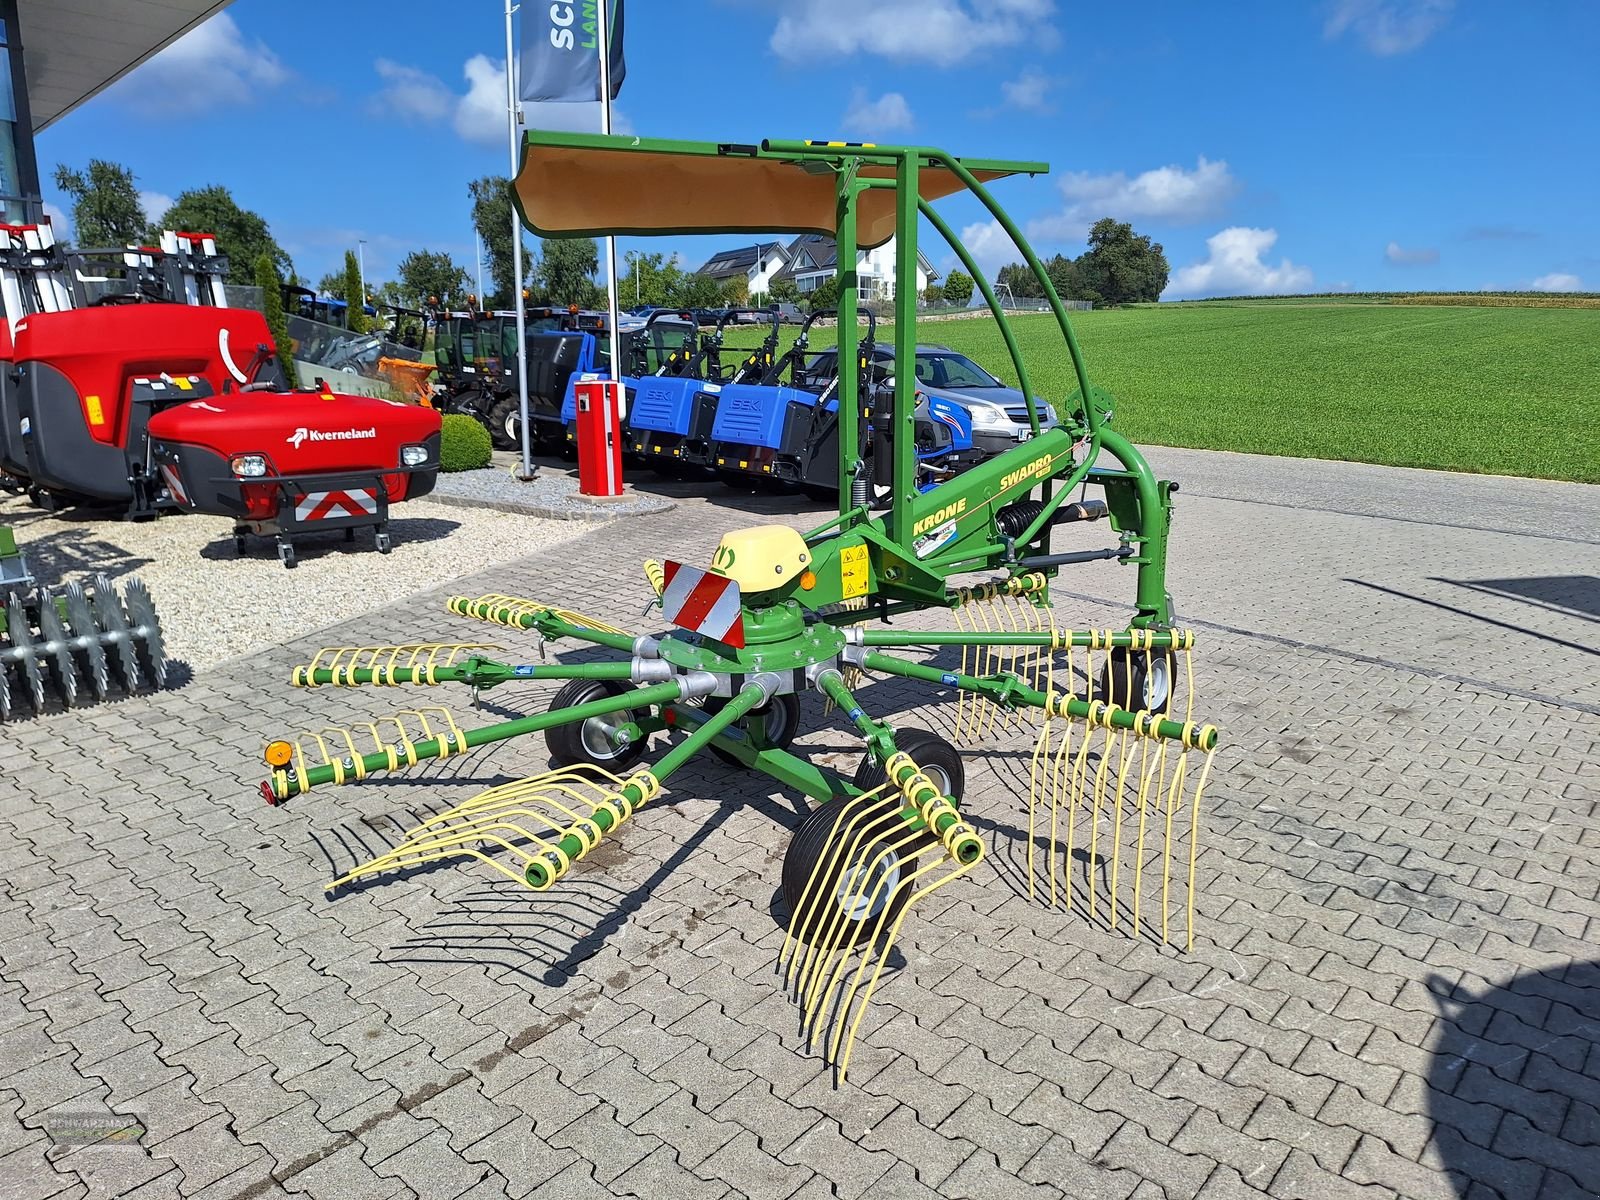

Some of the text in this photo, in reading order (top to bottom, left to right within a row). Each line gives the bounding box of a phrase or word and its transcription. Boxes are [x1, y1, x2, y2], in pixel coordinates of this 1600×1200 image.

[549, 0, 574, 51] SC
[581, 0, 597, 49] LAN
[309, 427, 376, 441] Kverneland
[1000, 453, 1052, 491] SWADRO
[913, 497, 967, 537] KRONE
